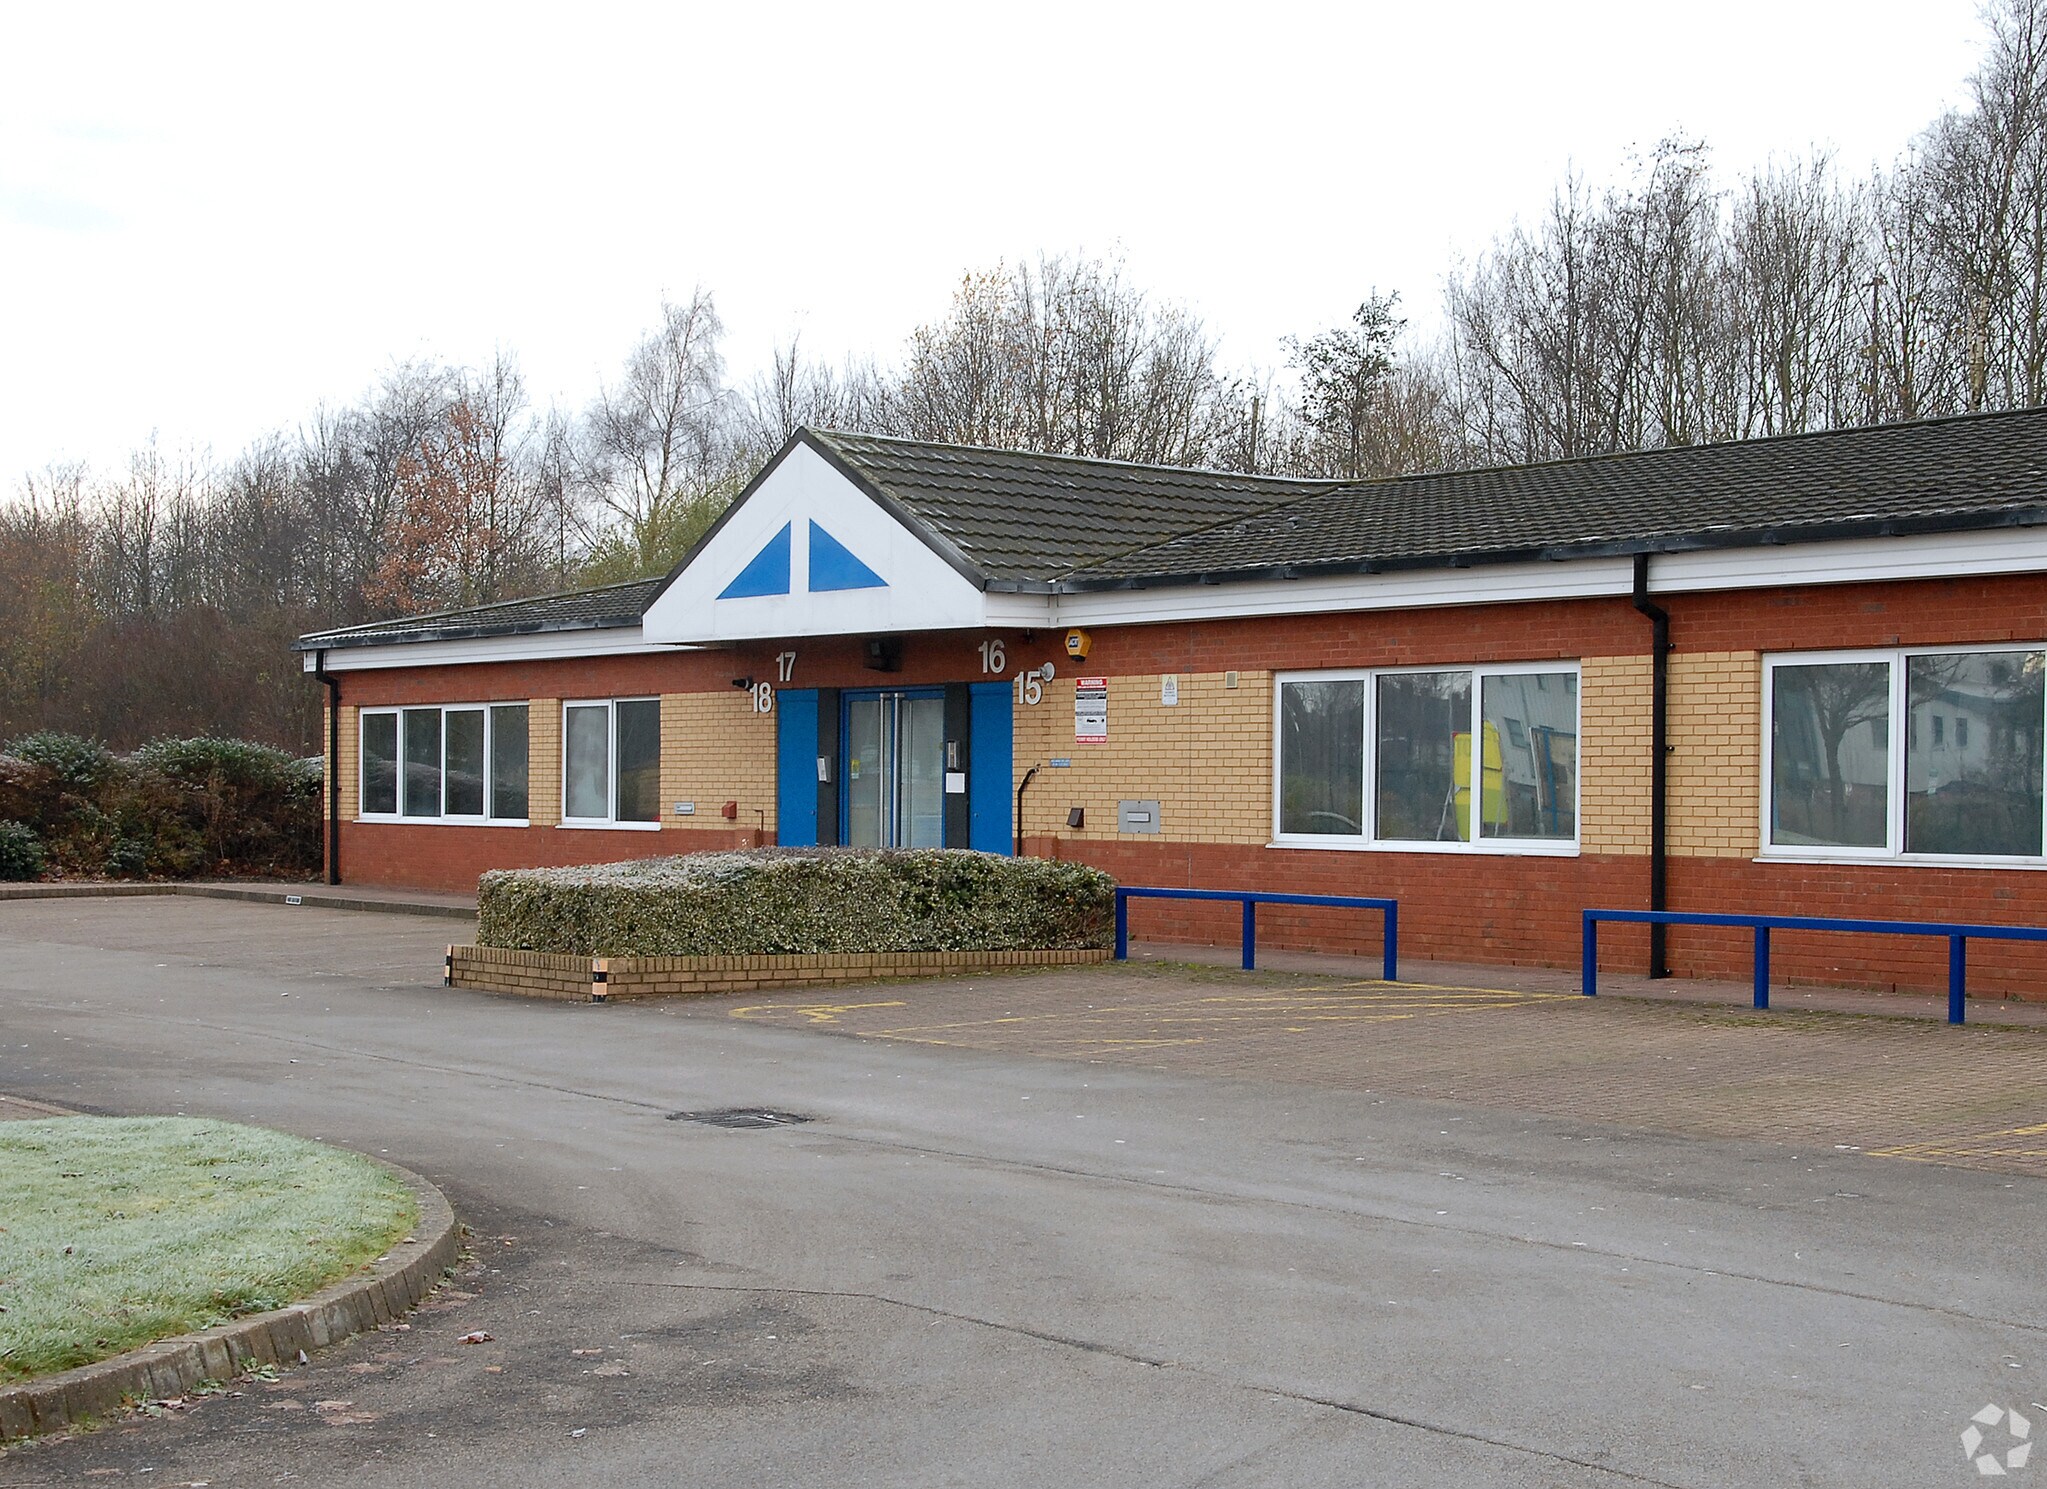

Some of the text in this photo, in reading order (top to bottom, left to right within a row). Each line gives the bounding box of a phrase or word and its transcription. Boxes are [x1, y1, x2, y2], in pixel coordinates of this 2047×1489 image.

[776, 651, 796, 682] 17
[978, 640, 1006, 674] 16
[751, 682, 773, 713] 18
[1014, 671, 1043, 705] 15
